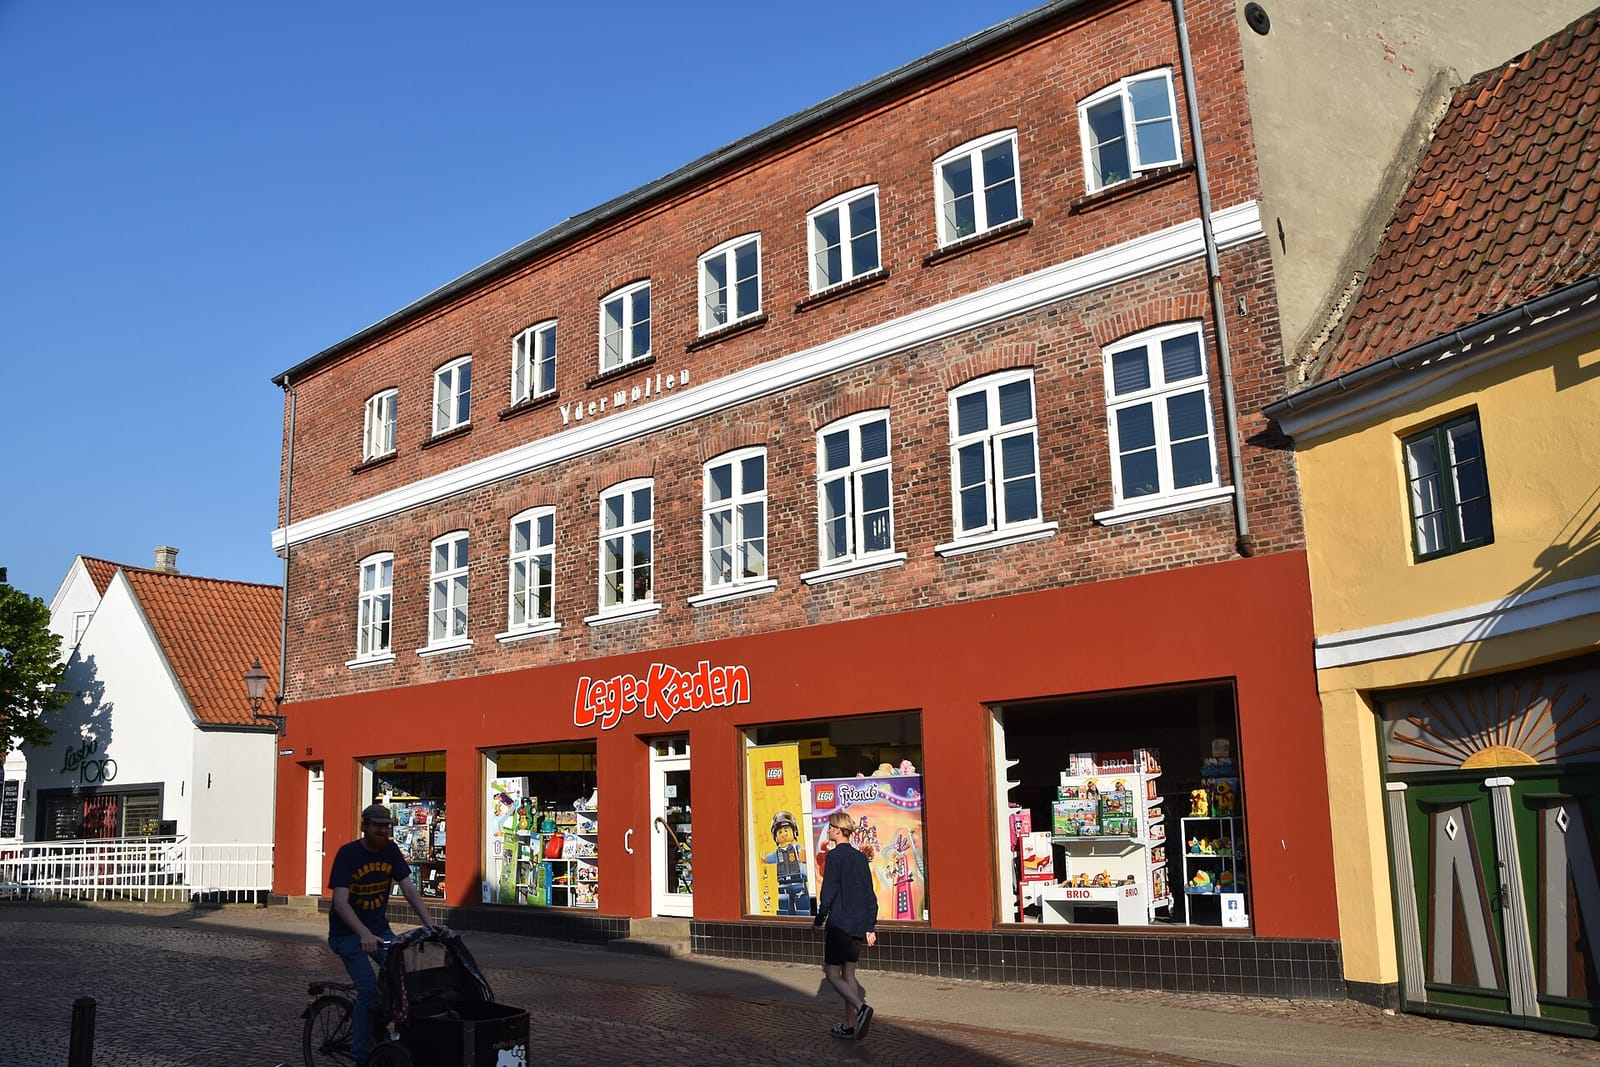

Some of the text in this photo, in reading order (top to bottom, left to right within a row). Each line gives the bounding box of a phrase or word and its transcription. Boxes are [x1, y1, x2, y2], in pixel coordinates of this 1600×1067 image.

[1103, 759, 1128, 768] BRIO
[767, 768, 782, 778] LEGO
[817, 784, 878, 806] LEGO Friends
[1066, 890, 1090, 899] BRIO
[1125, 887, 1139, 898] BRIO
